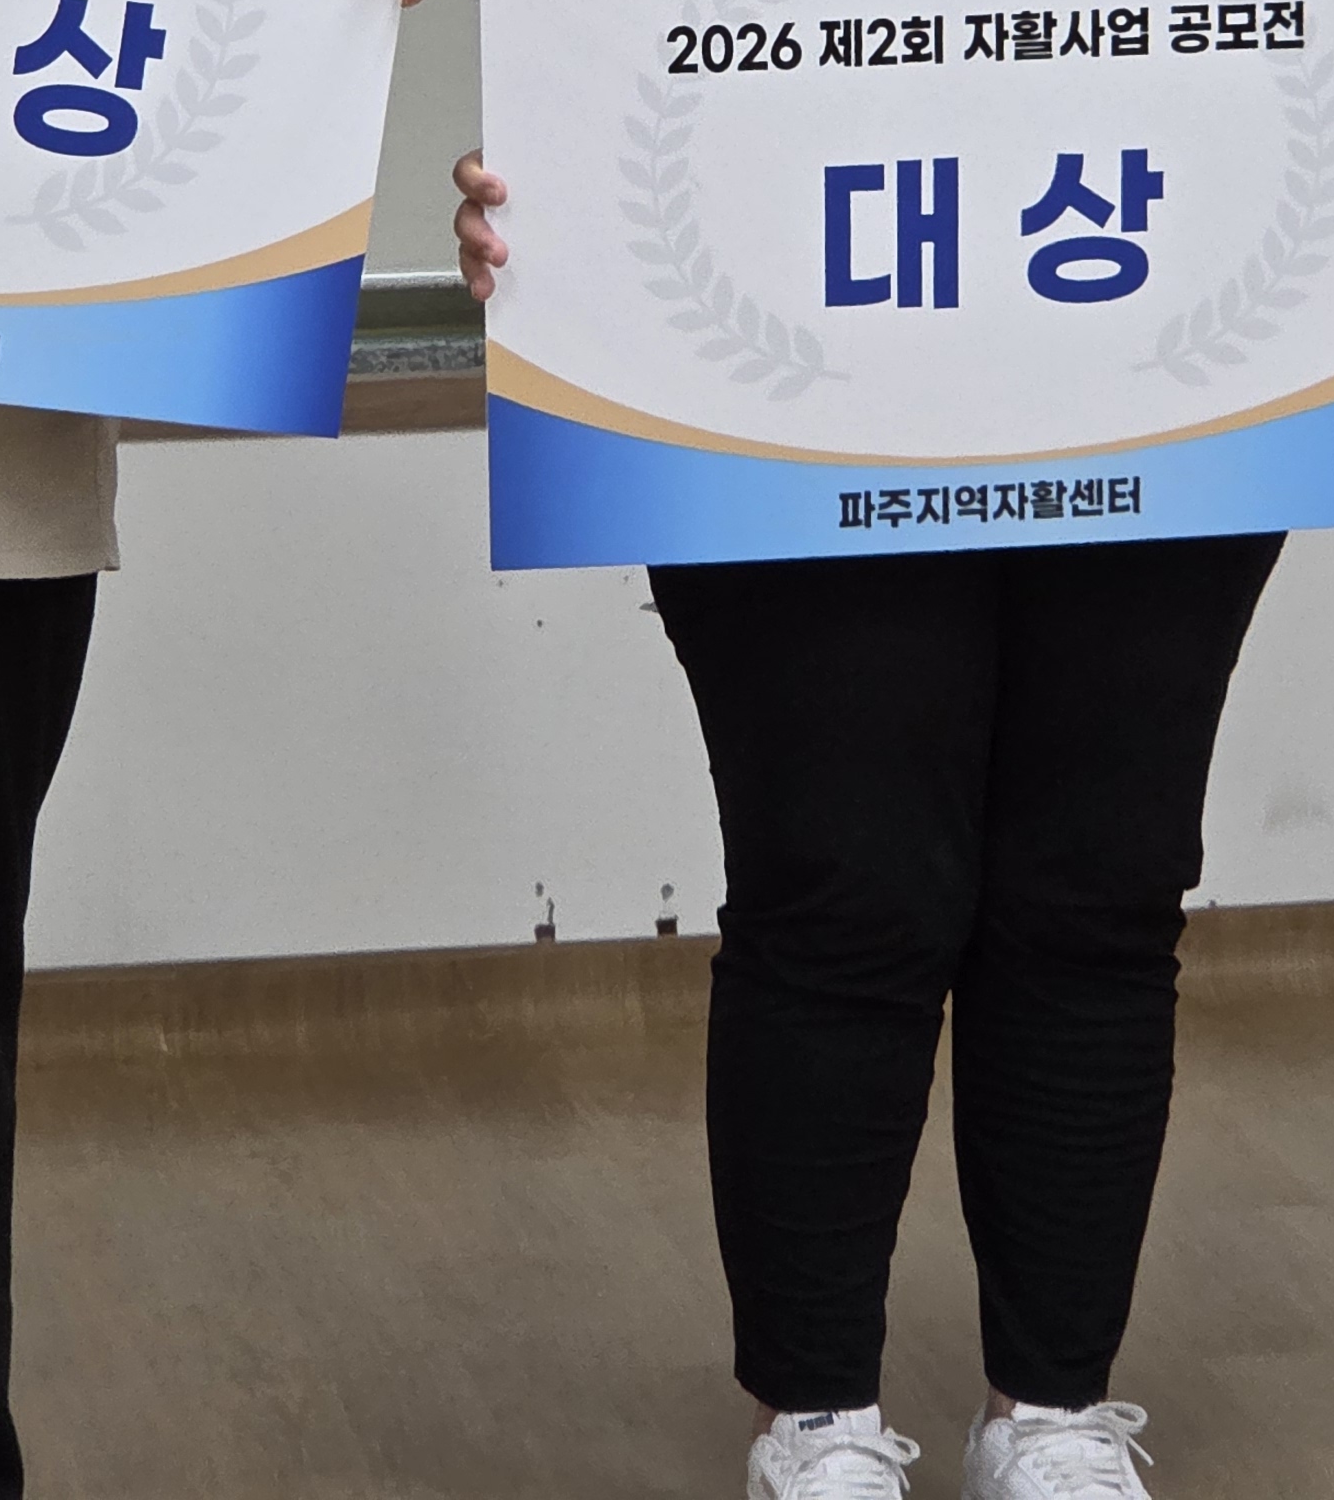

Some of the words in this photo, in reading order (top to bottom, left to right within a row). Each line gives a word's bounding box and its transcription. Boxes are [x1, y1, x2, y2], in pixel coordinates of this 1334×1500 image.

[666, 22, 803, 75] 2026
[819, 15, 945, 68] 제2회
[964, 7, 1150, 62] 자활사업
[1168, 0, 1306, 54] 공모전
[838, 476, 1142, 530] 파주지역자활센터
